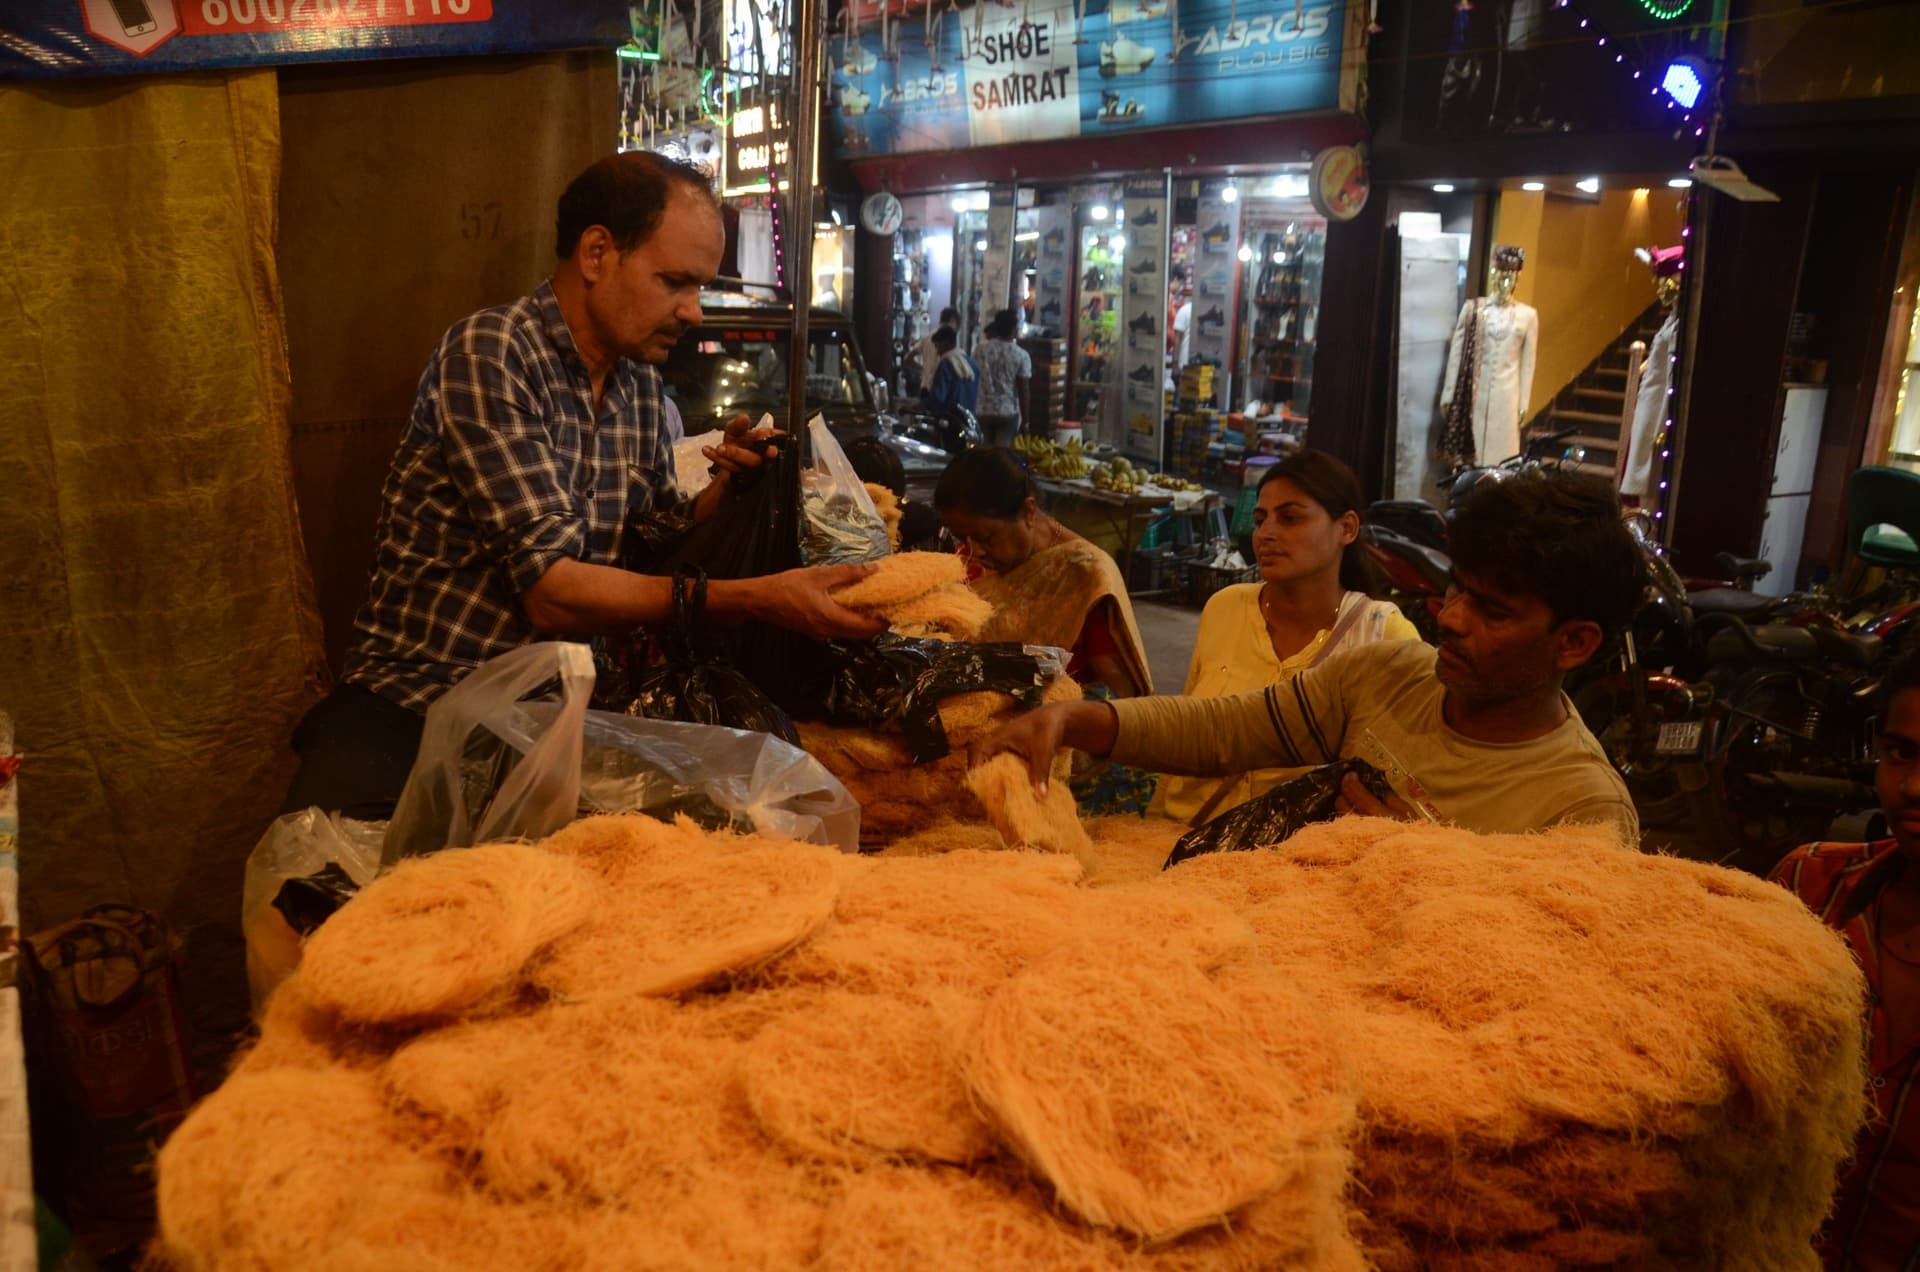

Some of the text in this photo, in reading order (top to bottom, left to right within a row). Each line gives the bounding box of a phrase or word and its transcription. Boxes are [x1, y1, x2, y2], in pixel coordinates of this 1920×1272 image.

[984, 23, 1050, 65] SHOE
[1193, 5, 1333, 55] ABROS
[1288, 43, 1330, 64] BIG
[973, 66, 1070, 112] SAMRAT
